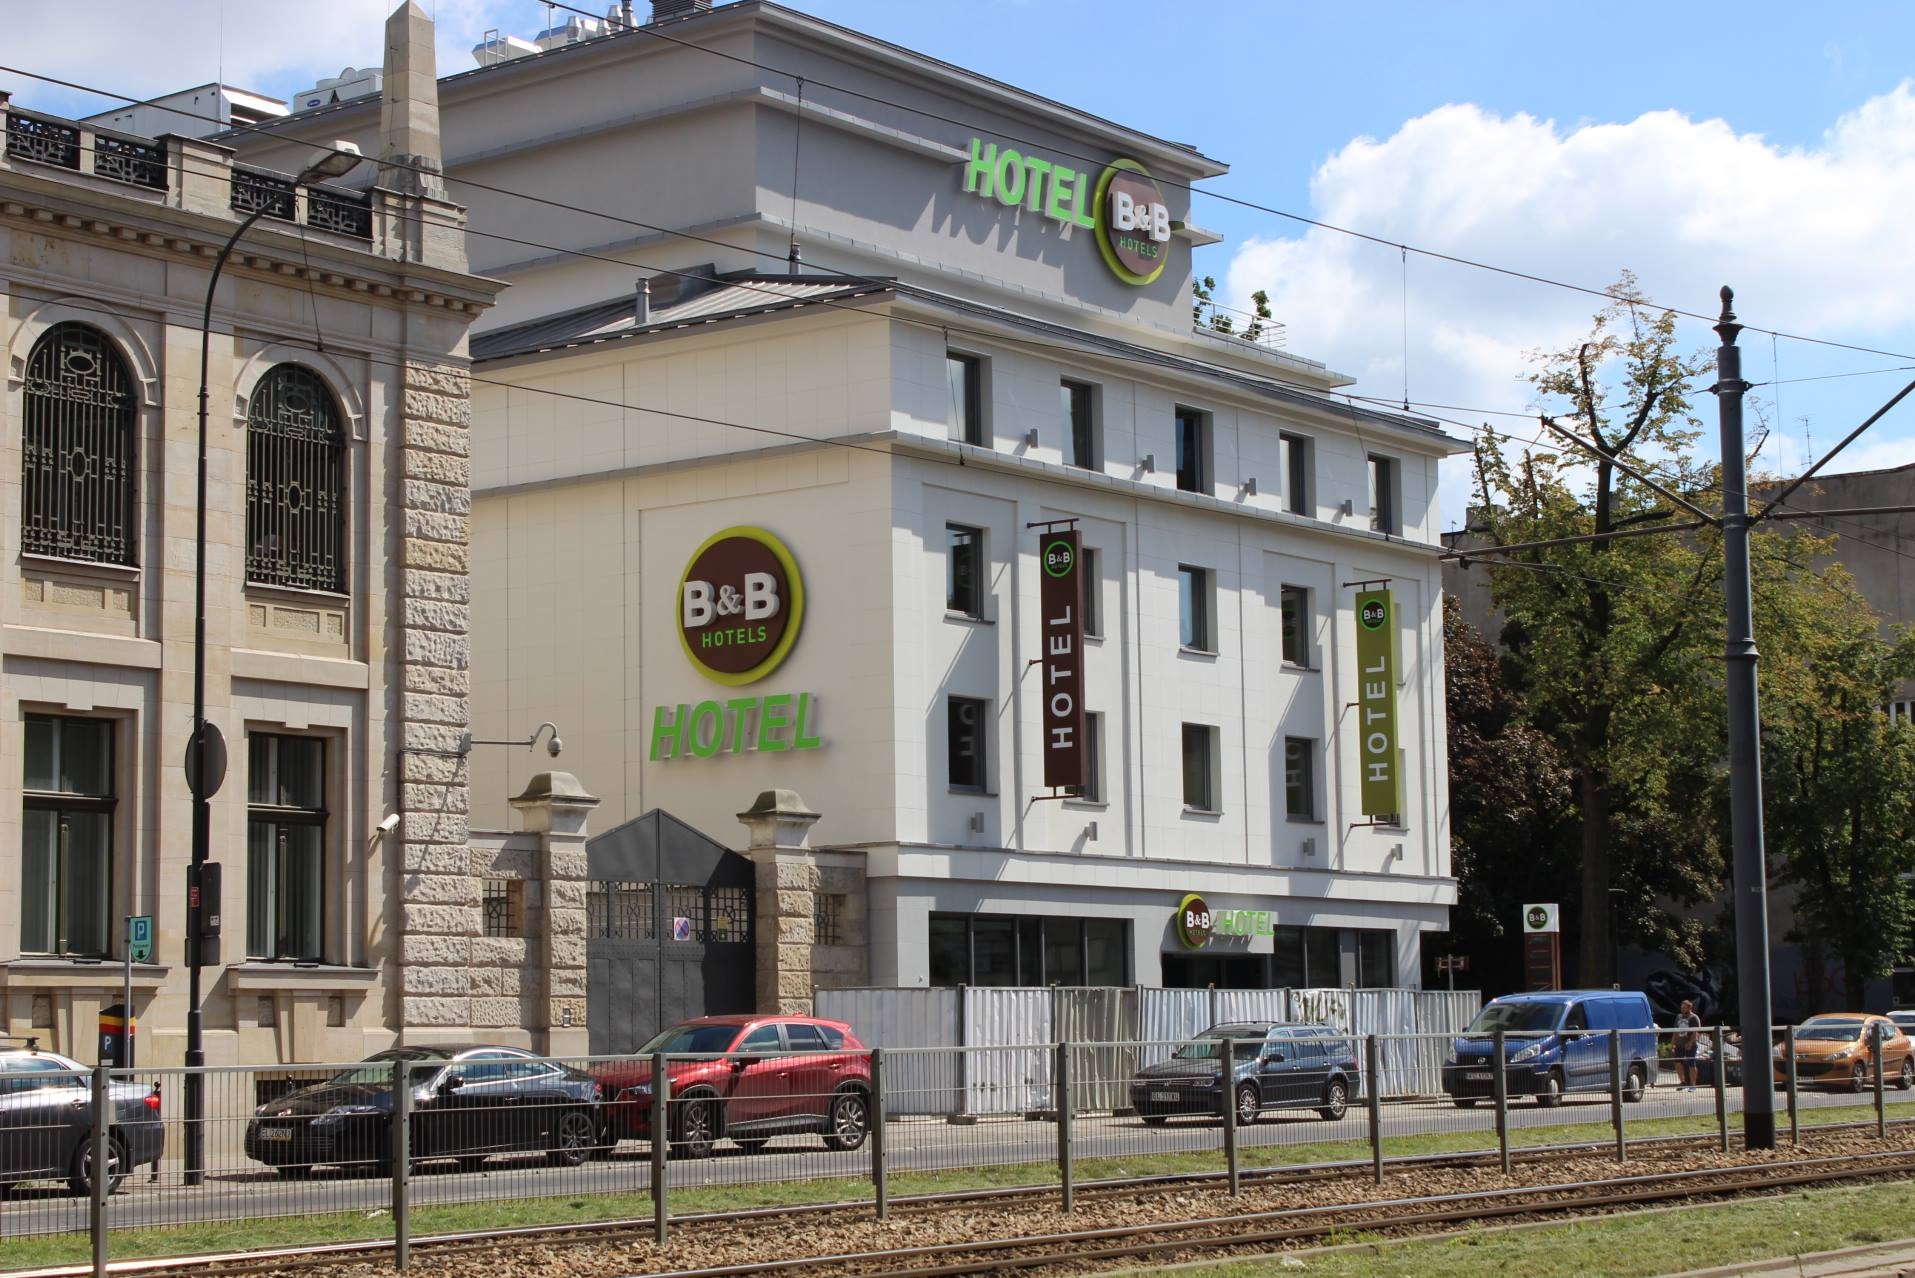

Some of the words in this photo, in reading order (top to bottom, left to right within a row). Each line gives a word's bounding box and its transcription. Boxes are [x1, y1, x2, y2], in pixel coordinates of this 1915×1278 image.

[964, 137, 1096, 230] HOTEL
[1112, 191, 1171, 242] B&B
[1119, 235, 1158, 258] HOTELS
[1048, 552, 1071, 565] B&B
[683, 572, 780, 628] B&B
[1363, 608, 1384, 620] B&B
[702, 626, 767, 648] HOTELS
[1050, 605, 1073, 749] HOTEL
[650, 692, 821, 762] HOTEL
[1365, 655, 1389, 782] HOTEL
[136, 922, 145, 940] P
[1186, 910, 1210, 929] B&B
[1220, 910, 1275, 937] HOTEL
[104, 1035, 112, 1050] P
